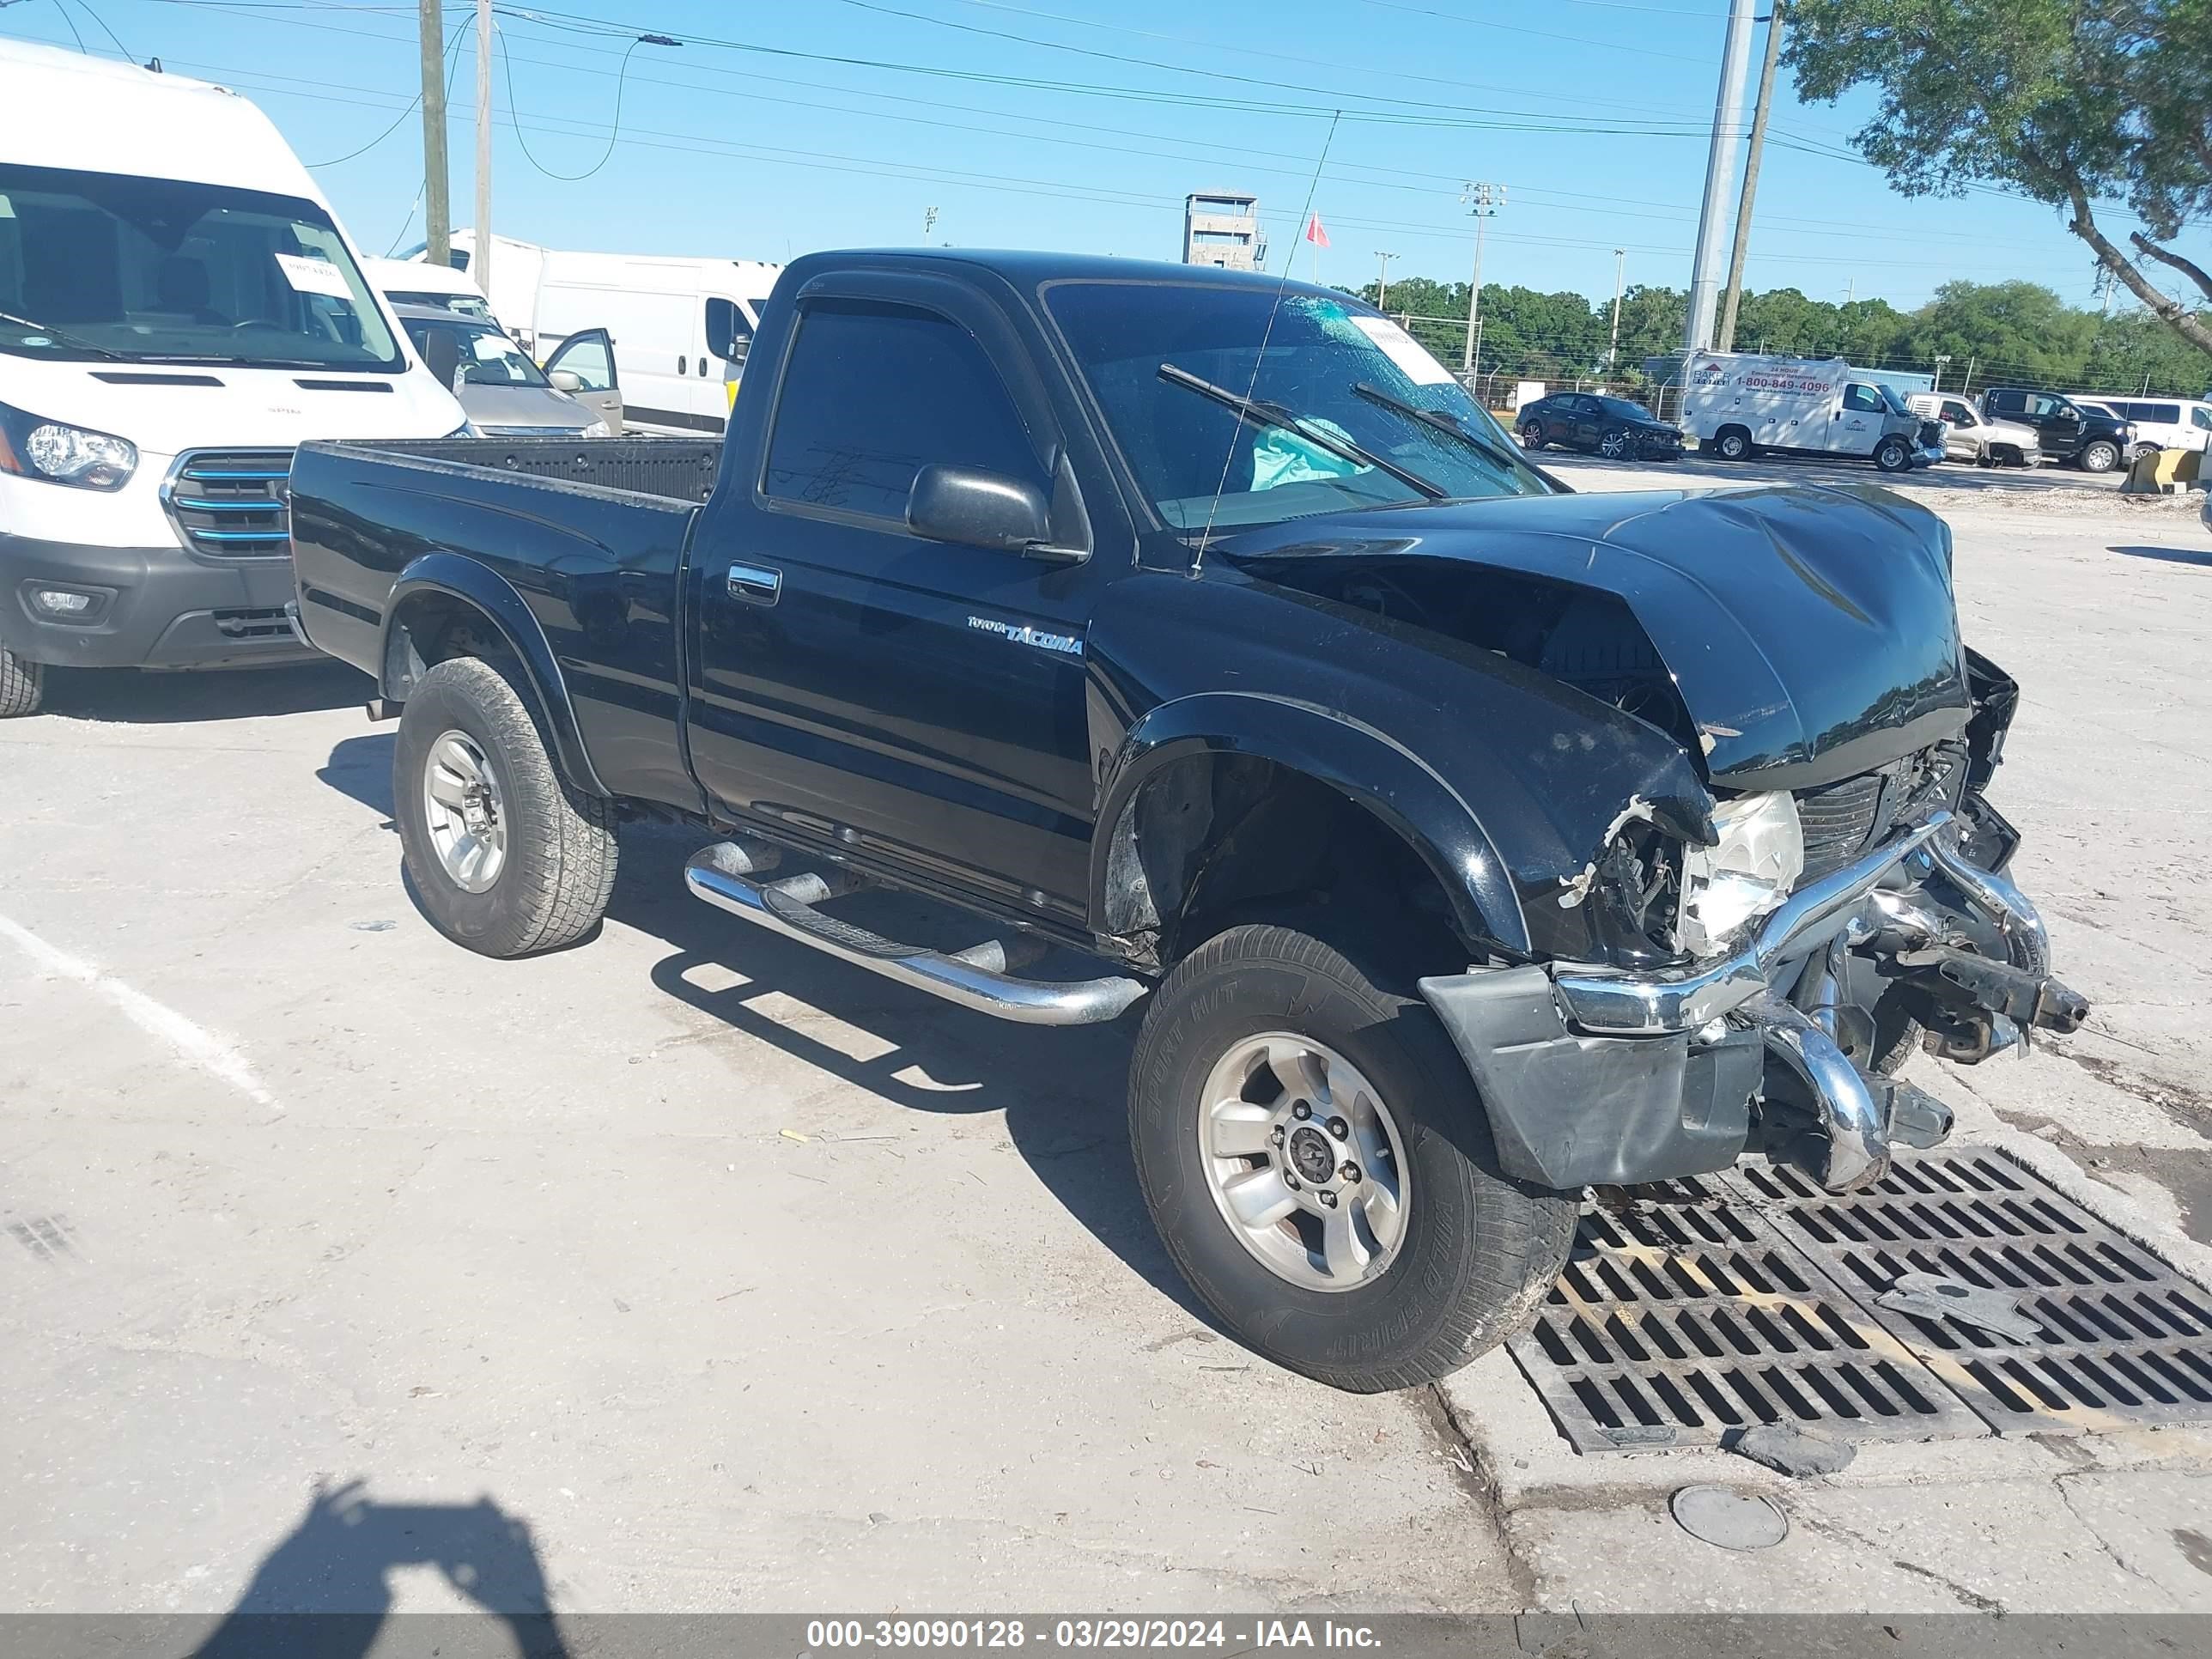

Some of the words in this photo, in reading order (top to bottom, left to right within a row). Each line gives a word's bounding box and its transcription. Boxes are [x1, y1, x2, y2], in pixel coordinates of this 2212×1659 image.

[1693, 370, 1731, 380] BAKER
[1736, 376, 1830, 392] 1-800-849-4096
[1751, 370, 1786, 379] Emergency
[1745, 387, 1816, 397] www.bakerroofing.com
[967, 615, 1006, 634] TOYOTA
[1006, 625, 1084, 655] TACOMA
[1146, 1017, 1186, 1130] SPORT
[1189, 981, 1238, 1024] H/T
[1422, 1199, 1454, 1300] WILD
[1325, 1296, 1425, 1358] SPIRIT
